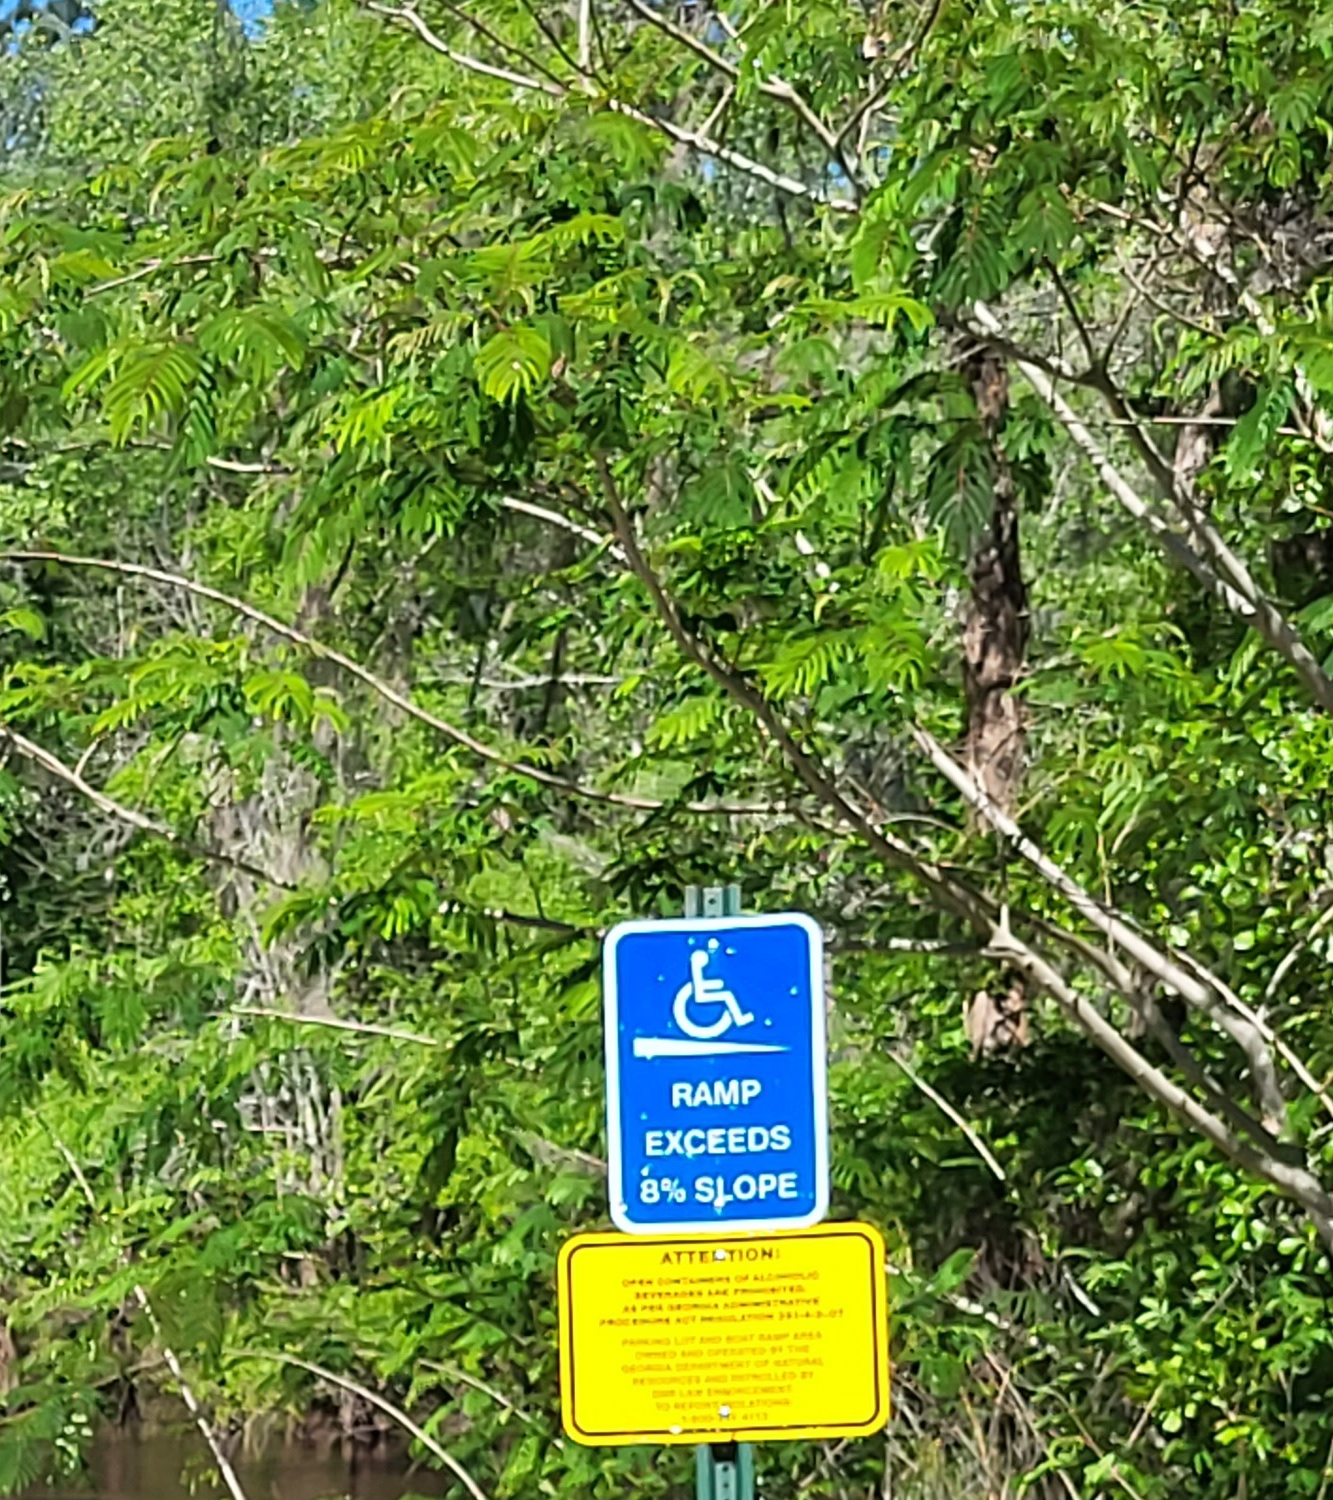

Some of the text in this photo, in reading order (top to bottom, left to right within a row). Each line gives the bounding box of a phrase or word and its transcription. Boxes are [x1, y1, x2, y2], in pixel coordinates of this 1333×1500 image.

[672, 1079, 761, 1107] RAMP
[645, 1125, 791, 1155] EXCEEDS
[640, 1172, 799, 1204] 8% SLOPE
